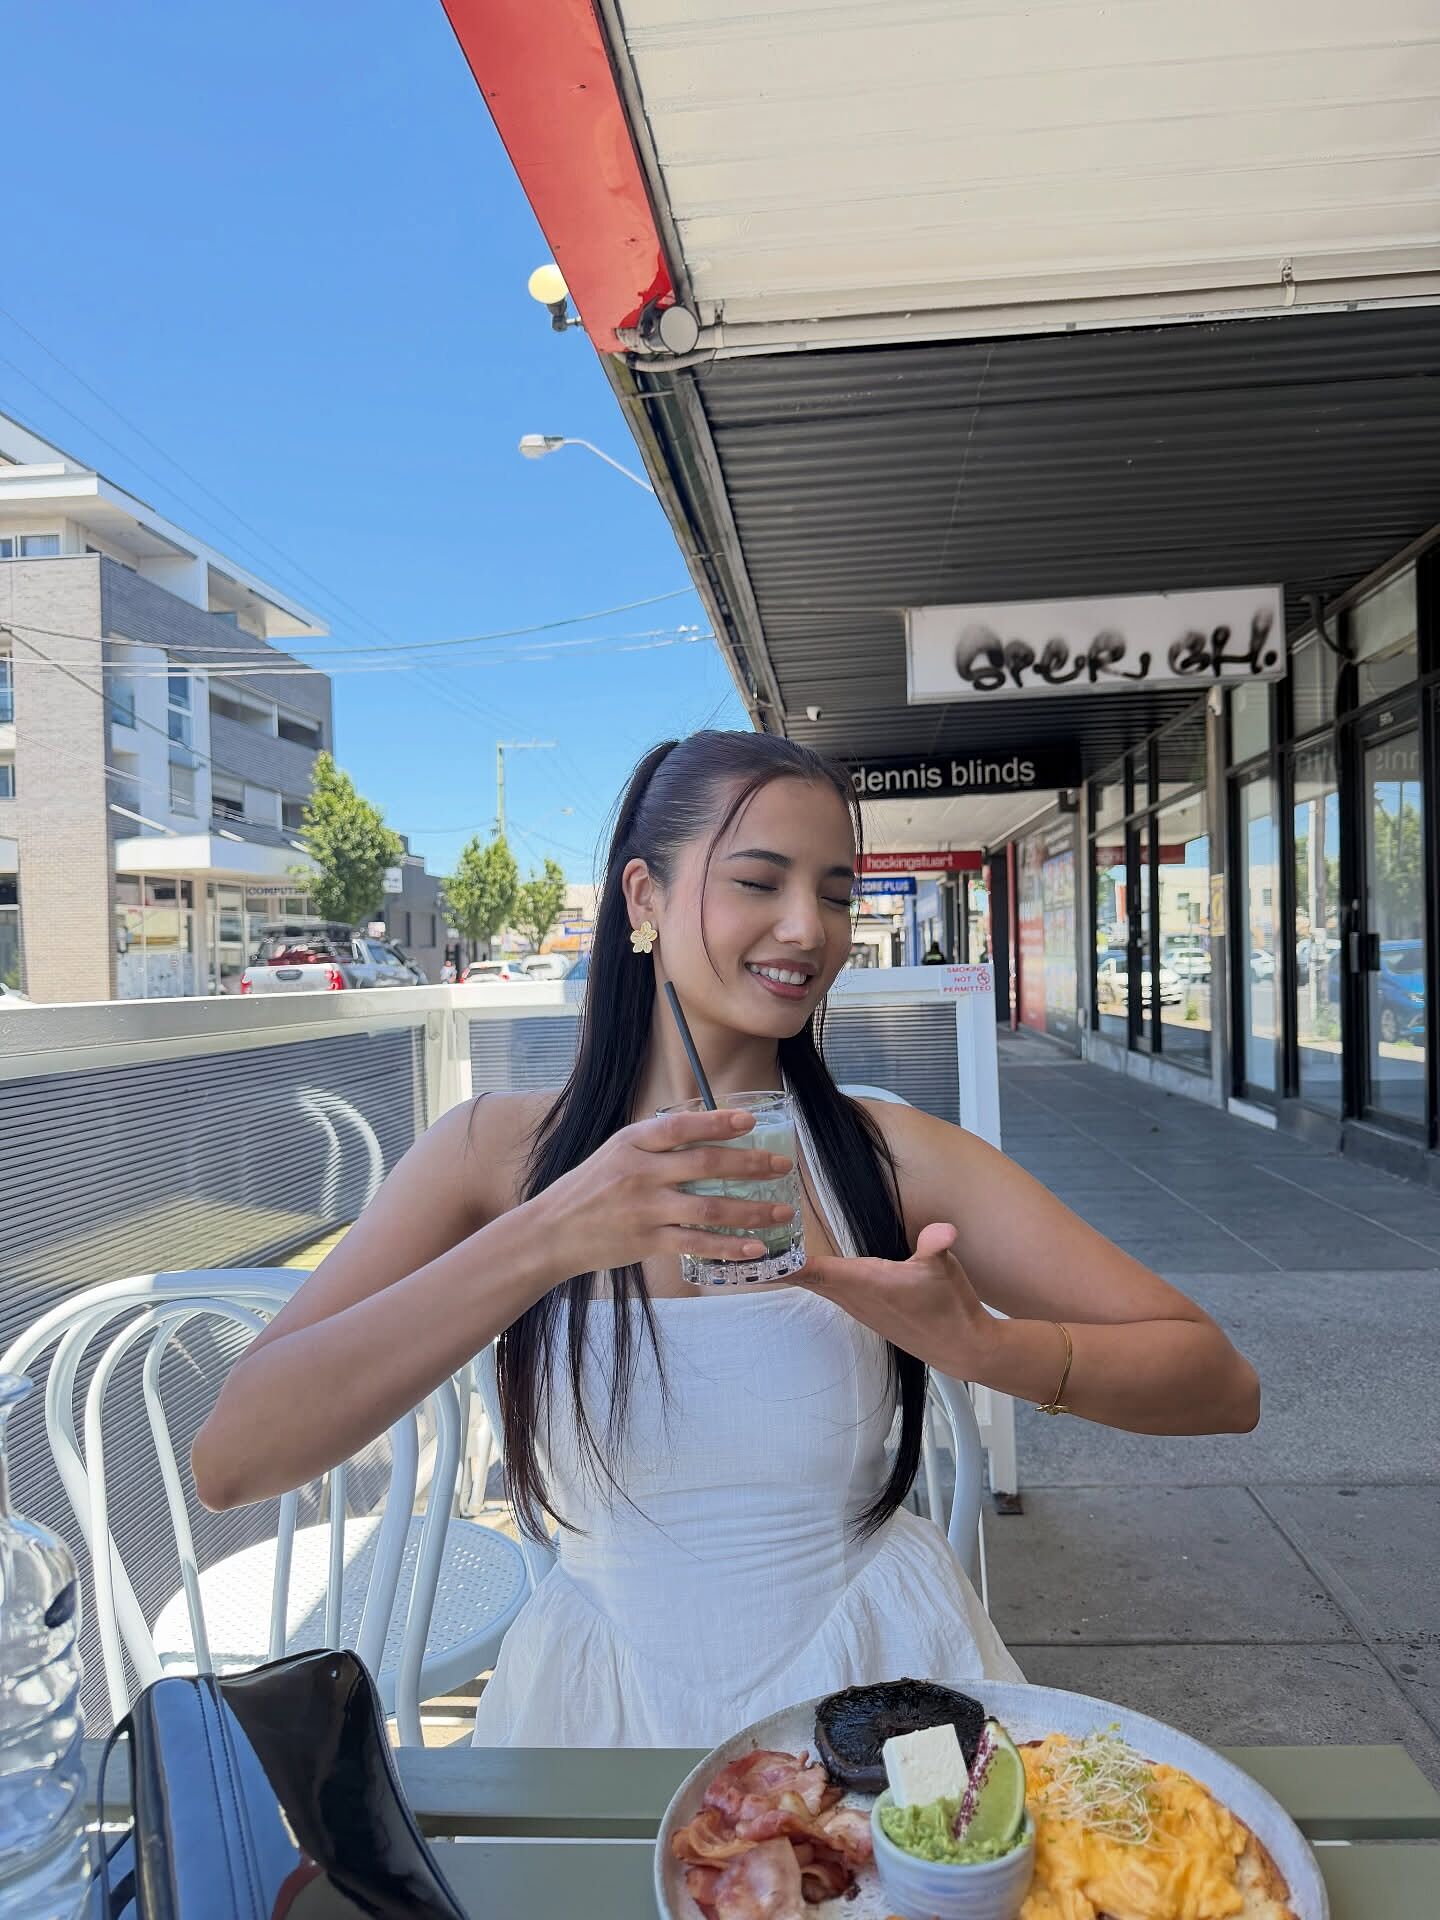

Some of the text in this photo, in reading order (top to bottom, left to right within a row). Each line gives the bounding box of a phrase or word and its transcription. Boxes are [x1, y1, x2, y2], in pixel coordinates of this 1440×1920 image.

[851, 757, 1036, 793] dennis blinds
[946, 965, 986, 973] SMOKING
[943, 985, 992, 993] PERMITTED
